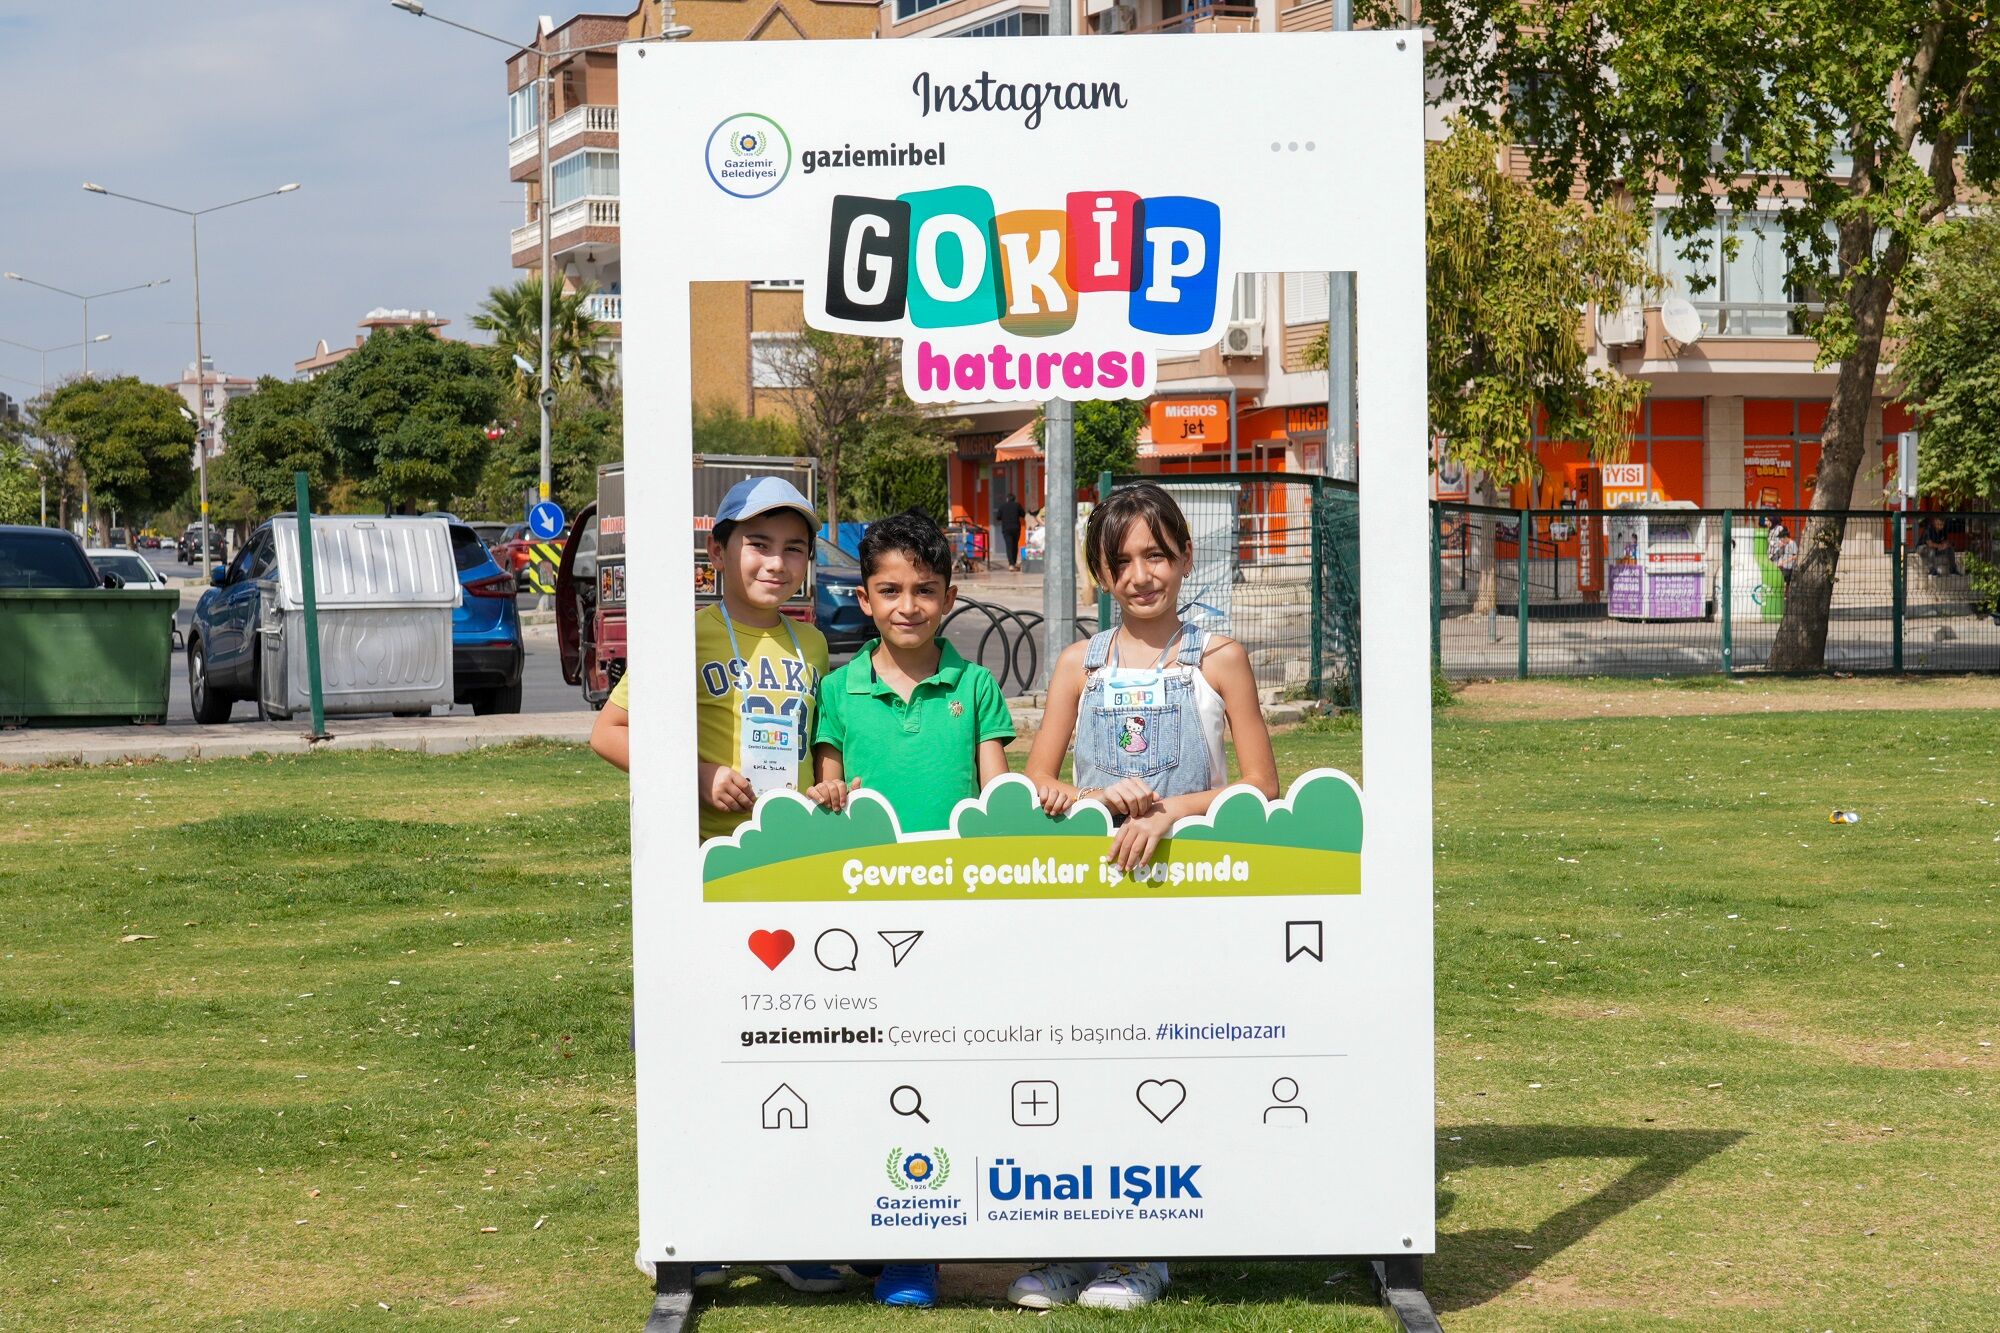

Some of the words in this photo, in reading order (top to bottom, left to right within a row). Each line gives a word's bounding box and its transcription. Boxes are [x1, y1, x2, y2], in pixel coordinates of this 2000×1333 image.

[913, 71, 1127, 130] Instagram
[724, 158, 773, 168] Gaziemir
[801, 142, 945, 174] gaziemirbel
[721, 169, 777, 179] Belediyesi
[843, 197, 1206, 315] GOKİP
[917, 341, 1146, 392] hatırası
[1180, 419, 1205, 439] jet
[1288, 406, 1328, 433] MiGR
[843, 858, 952, 893] Çevreci
[964, 858, 1090, 893] çocuklar
[740, 993, 817, 1011] 173.876
[823, 993, 878, 1011] views
[740, 1026, 884, 1048] gaziemirbel:
[888, 1025, 956, 1047] Çevreci
[963, 1024, 1043, 1046] çocuklar
[1050, 1024, 1064, 1045] iş
[1071, 1023, 1151, 1045] başında.
[1155, 1022, 1286, 1042] #ikincielpazarı
[988, 1157, 1093, 1202] Ünal
[1109, 1164, 1203, 1207] IŞIK
[876, 1195, 962, 1210] Gaziemir
[988, 1207, 1059, 1221] GAZİEMİR
[1063, 1206, 1135, 1220] BELEDİYE
[1139, 1206, 1204, 1222] BAŞKANI
[871, 1212, 967, 1230] Belediyesi
